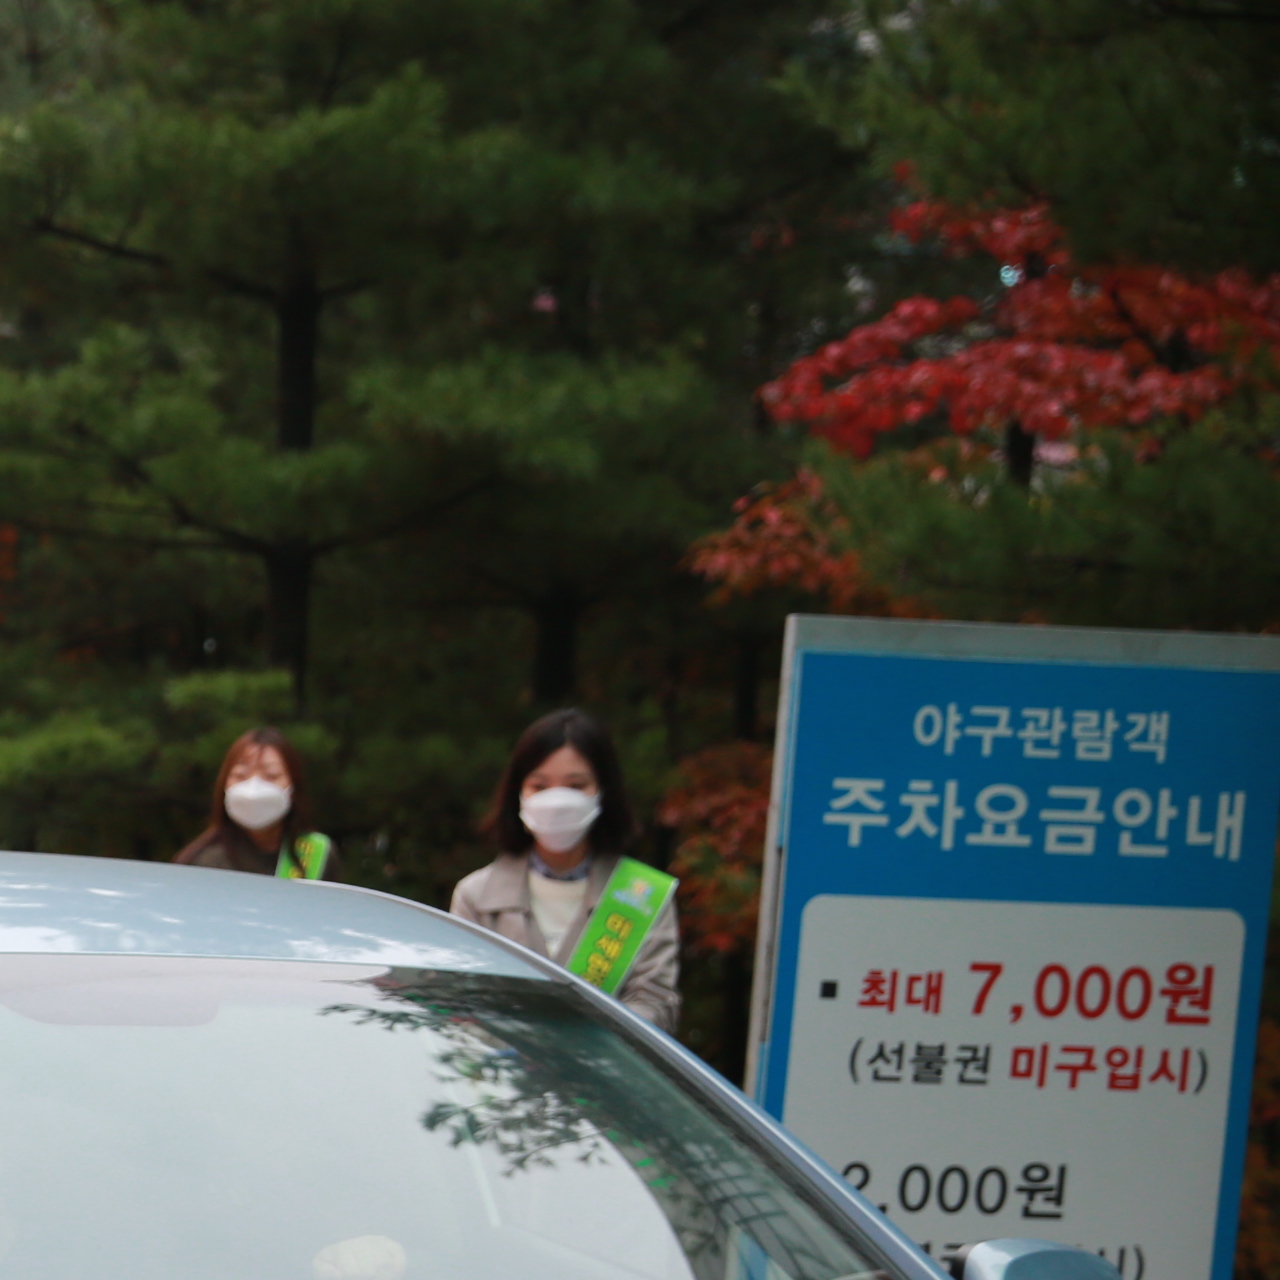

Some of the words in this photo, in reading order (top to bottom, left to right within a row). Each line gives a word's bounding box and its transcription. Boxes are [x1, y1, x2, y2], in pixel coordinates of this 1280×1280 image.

[913, 702, 1169, 764] 야구관람객
[823, 777, 1246, 862] 주차요금안내
[857, 968, 945, 1014] 최대
[968, 961, 1215, 1026] 7,000원
[848, 1037, 992, 1085] (선불권
[1009, 1042, 1209, 1093] 미구입시)
